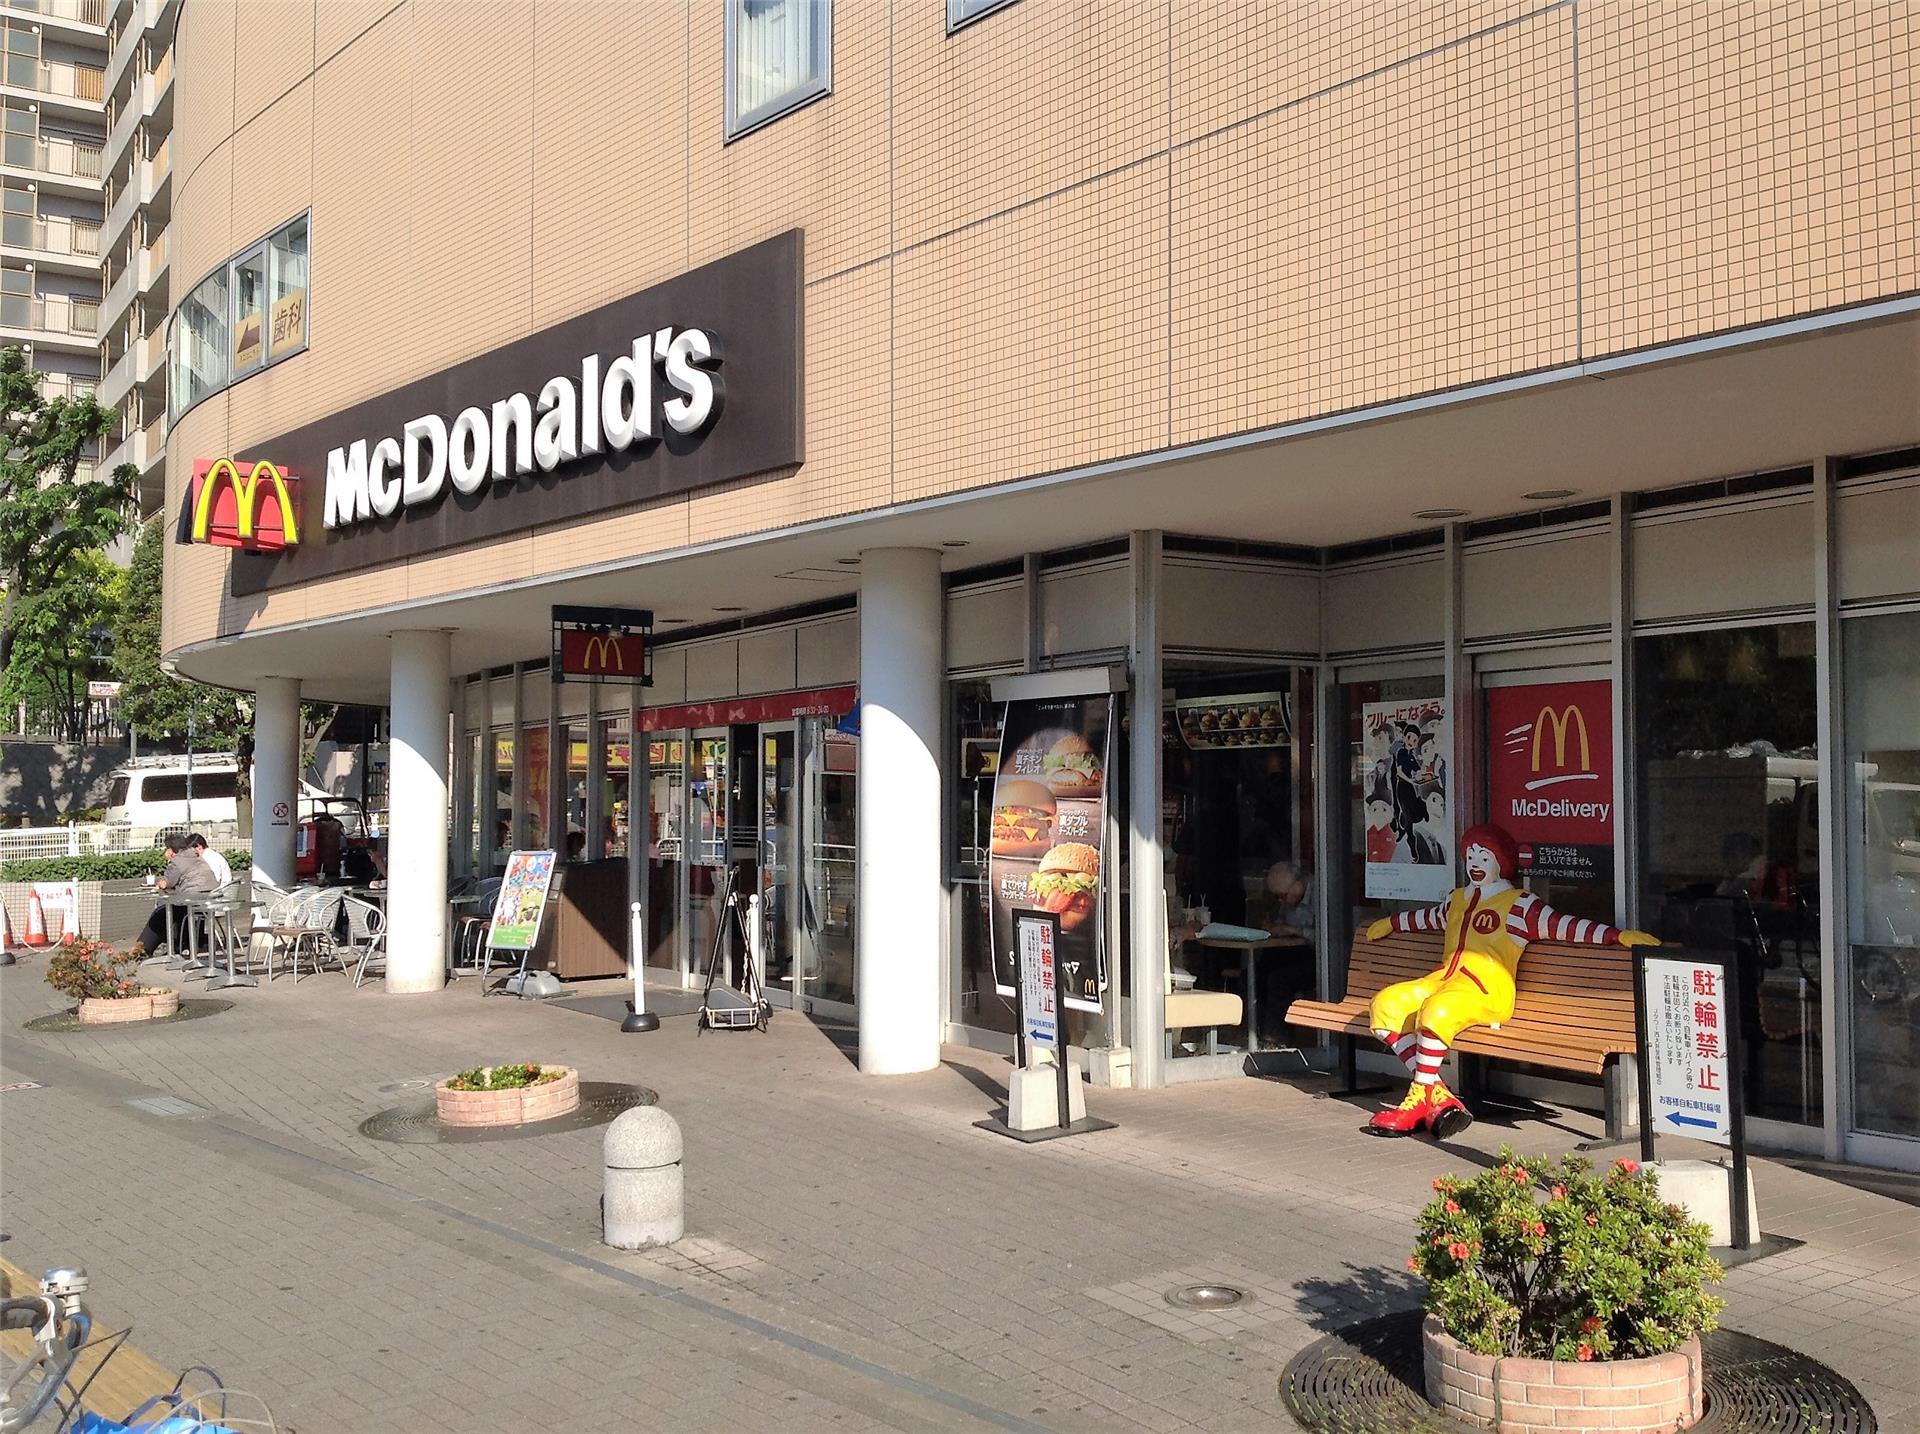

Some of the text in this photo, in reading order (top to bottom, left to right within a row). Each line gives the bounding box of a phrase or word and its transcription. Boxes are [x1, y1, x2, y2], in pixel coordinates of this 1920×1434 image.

[273, 298, 302, 346] 歯科
[322, 325, 721, 532] McDonald's
[1511, 798, 1610, 823] McDelivery
[1539, 847, 1577, 857] こちらからは
[1539, 856, 1593, 866] 出入りできません
[1040, 925, 1054, 1013] 駐輪禁止
[1693, 969, 1720, 1092] 駐輪禁止
